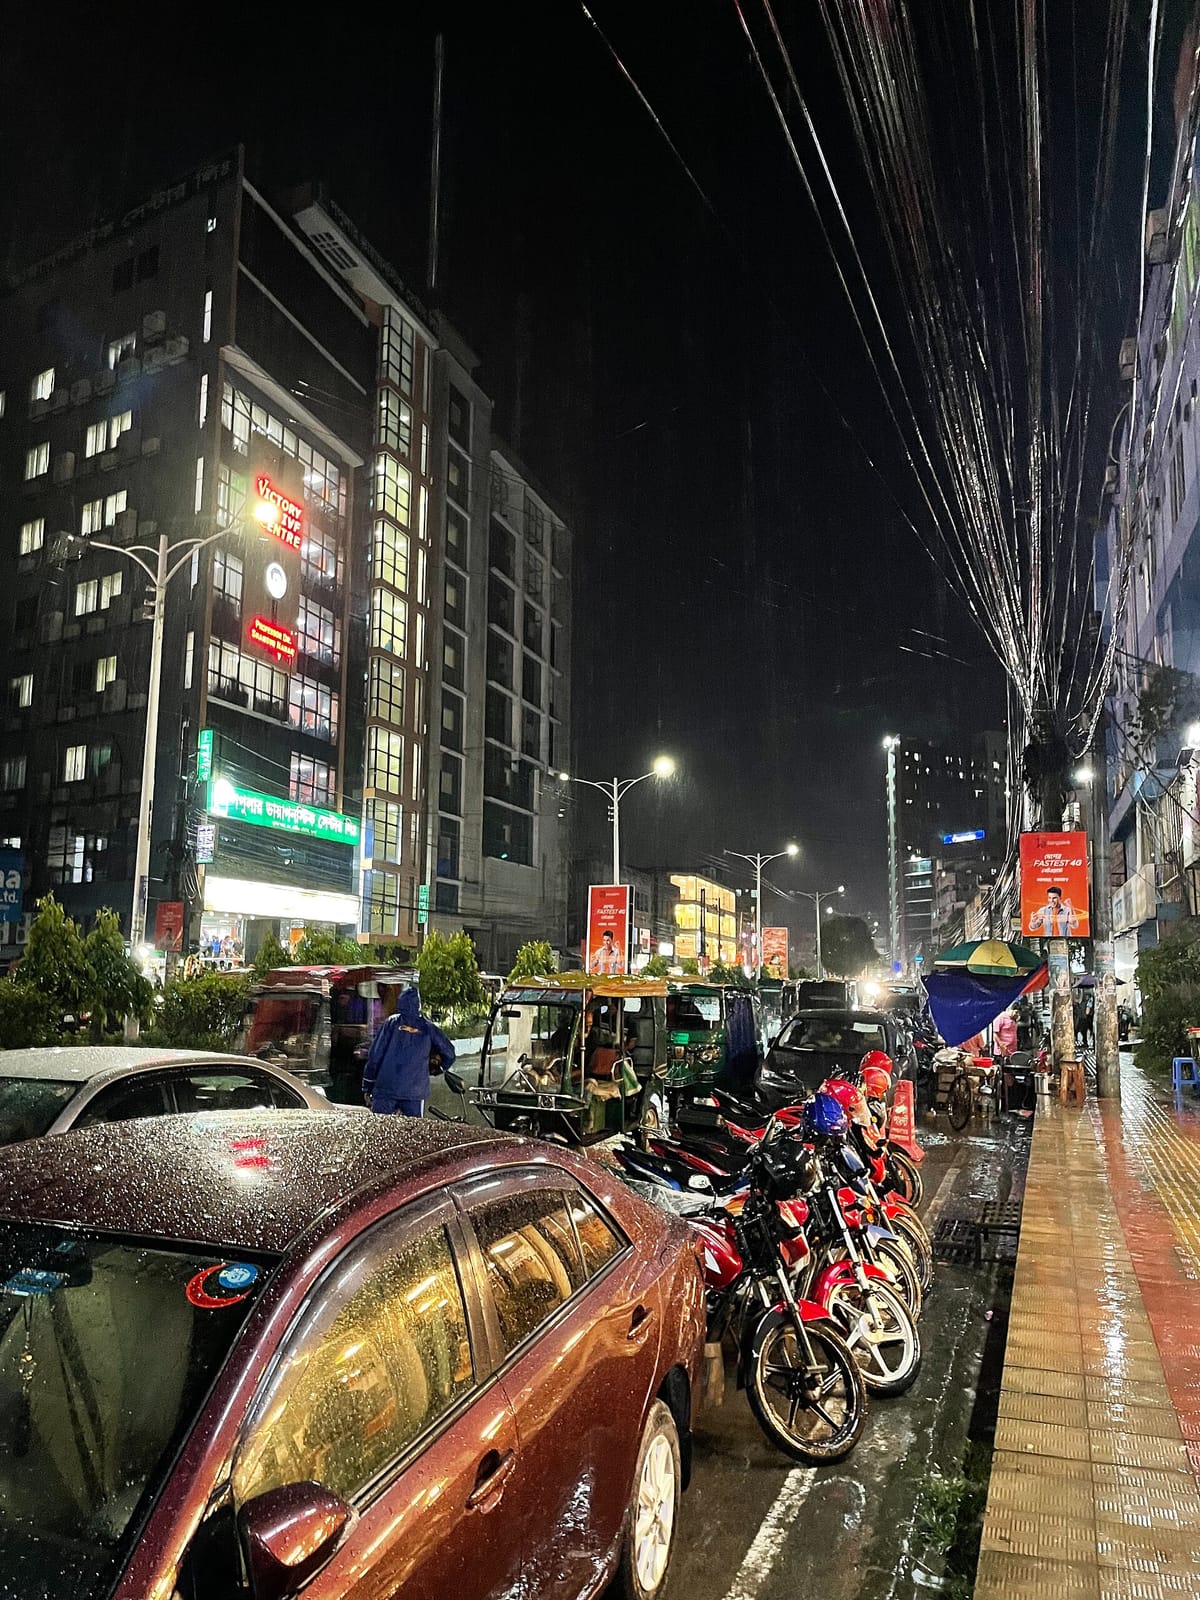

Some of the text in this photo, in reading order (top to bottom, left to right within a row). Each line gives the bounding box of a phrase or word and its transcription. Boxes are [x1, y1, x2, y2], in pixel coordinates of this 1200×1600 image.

[257, 478, 302, 519] VICTORY
[281, 513, 301, 532] IVF
[1033, 859, 1082, 867] FASTEST 4G
